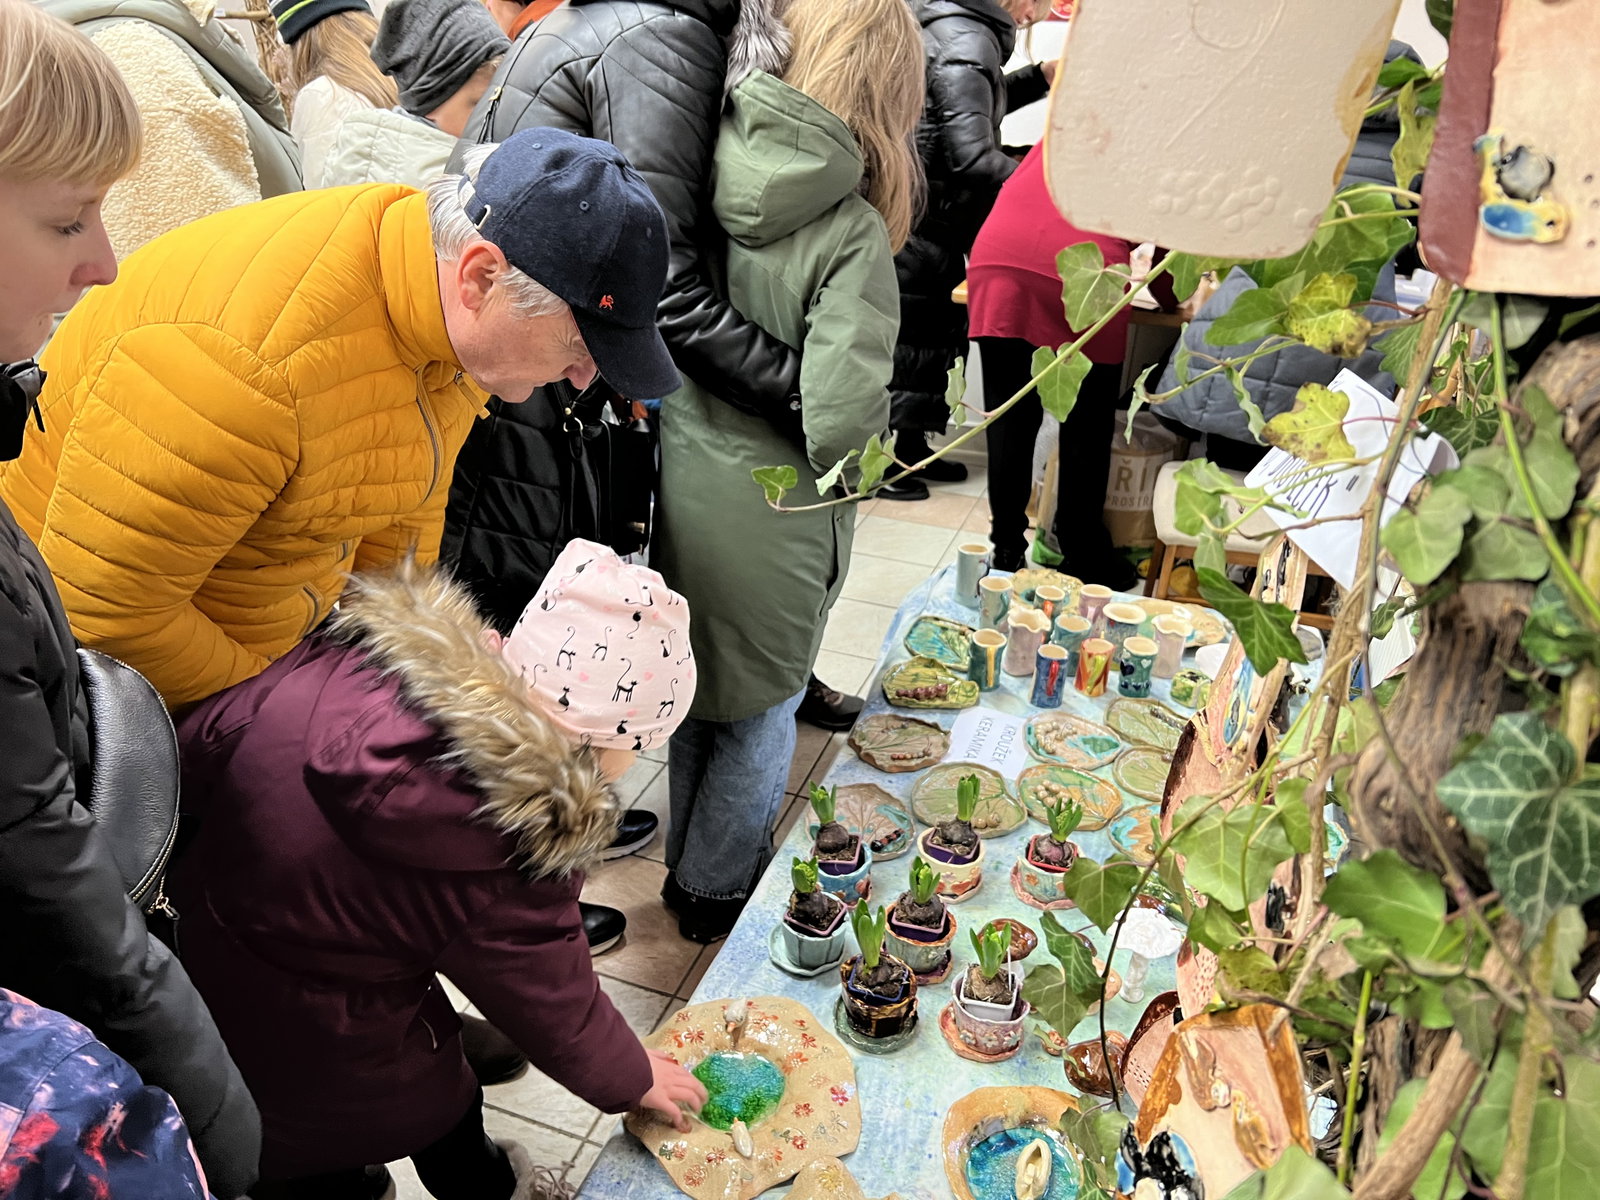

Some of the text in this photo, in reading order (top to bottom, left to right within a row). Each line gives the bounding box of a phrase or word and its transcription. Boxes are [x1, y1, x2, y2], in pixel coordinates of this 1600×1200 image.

[1115, 458, 1160, 492] ŘÍ
[963, 715, 995, 759] KERAMIKA
[989, 723, 1018, 765] KROUŽEK
